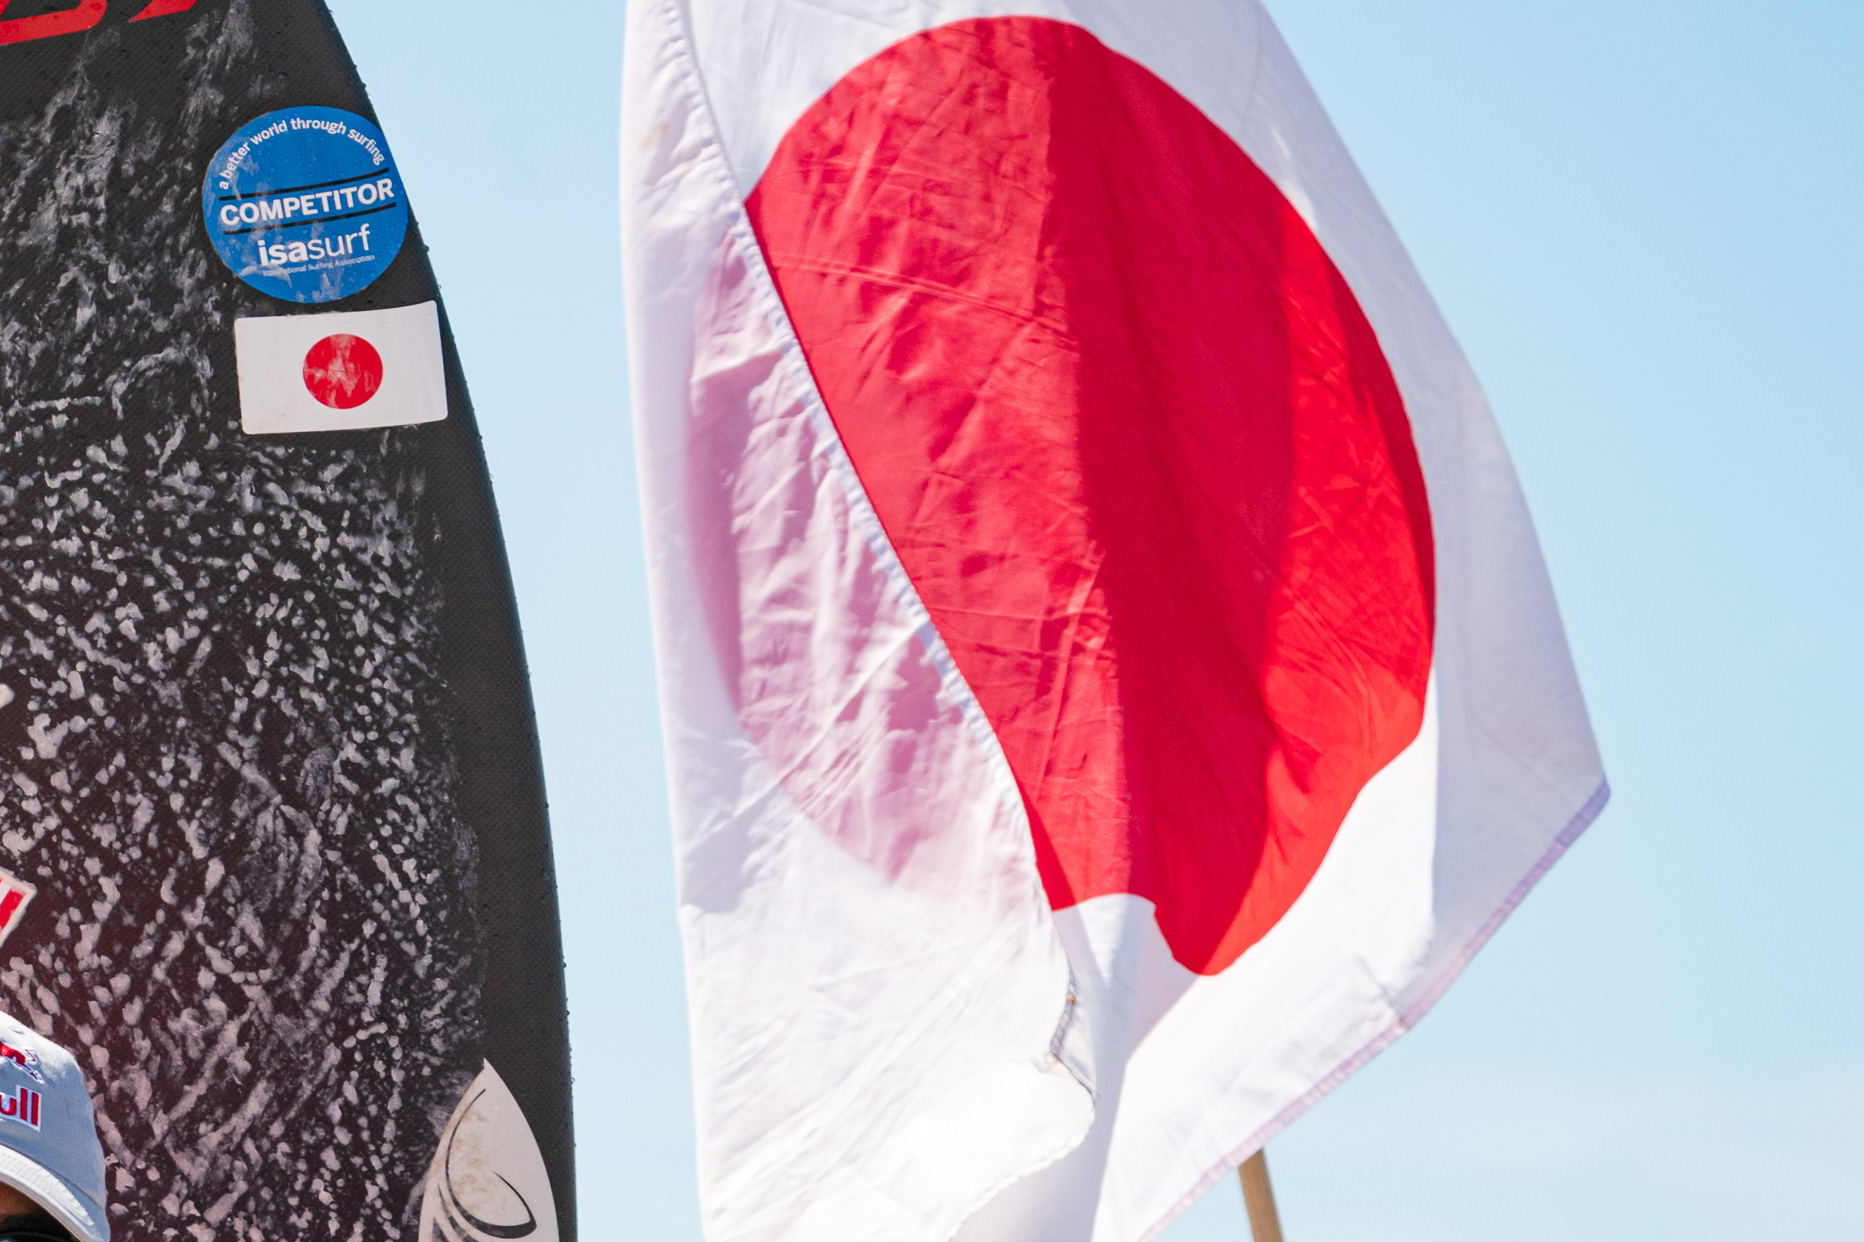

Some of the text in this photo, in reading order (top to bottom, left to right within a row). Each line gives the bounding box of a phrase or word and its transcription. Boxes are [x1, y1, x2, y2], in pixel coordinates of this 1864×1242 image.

[219, 117, 385, 190] a better world through surfing
[220, 178, 395, 226] COMPETITOR
[258, 223, 370, 266] isasurf
[263, 254, 376, 277] Intetional Surfing Association
